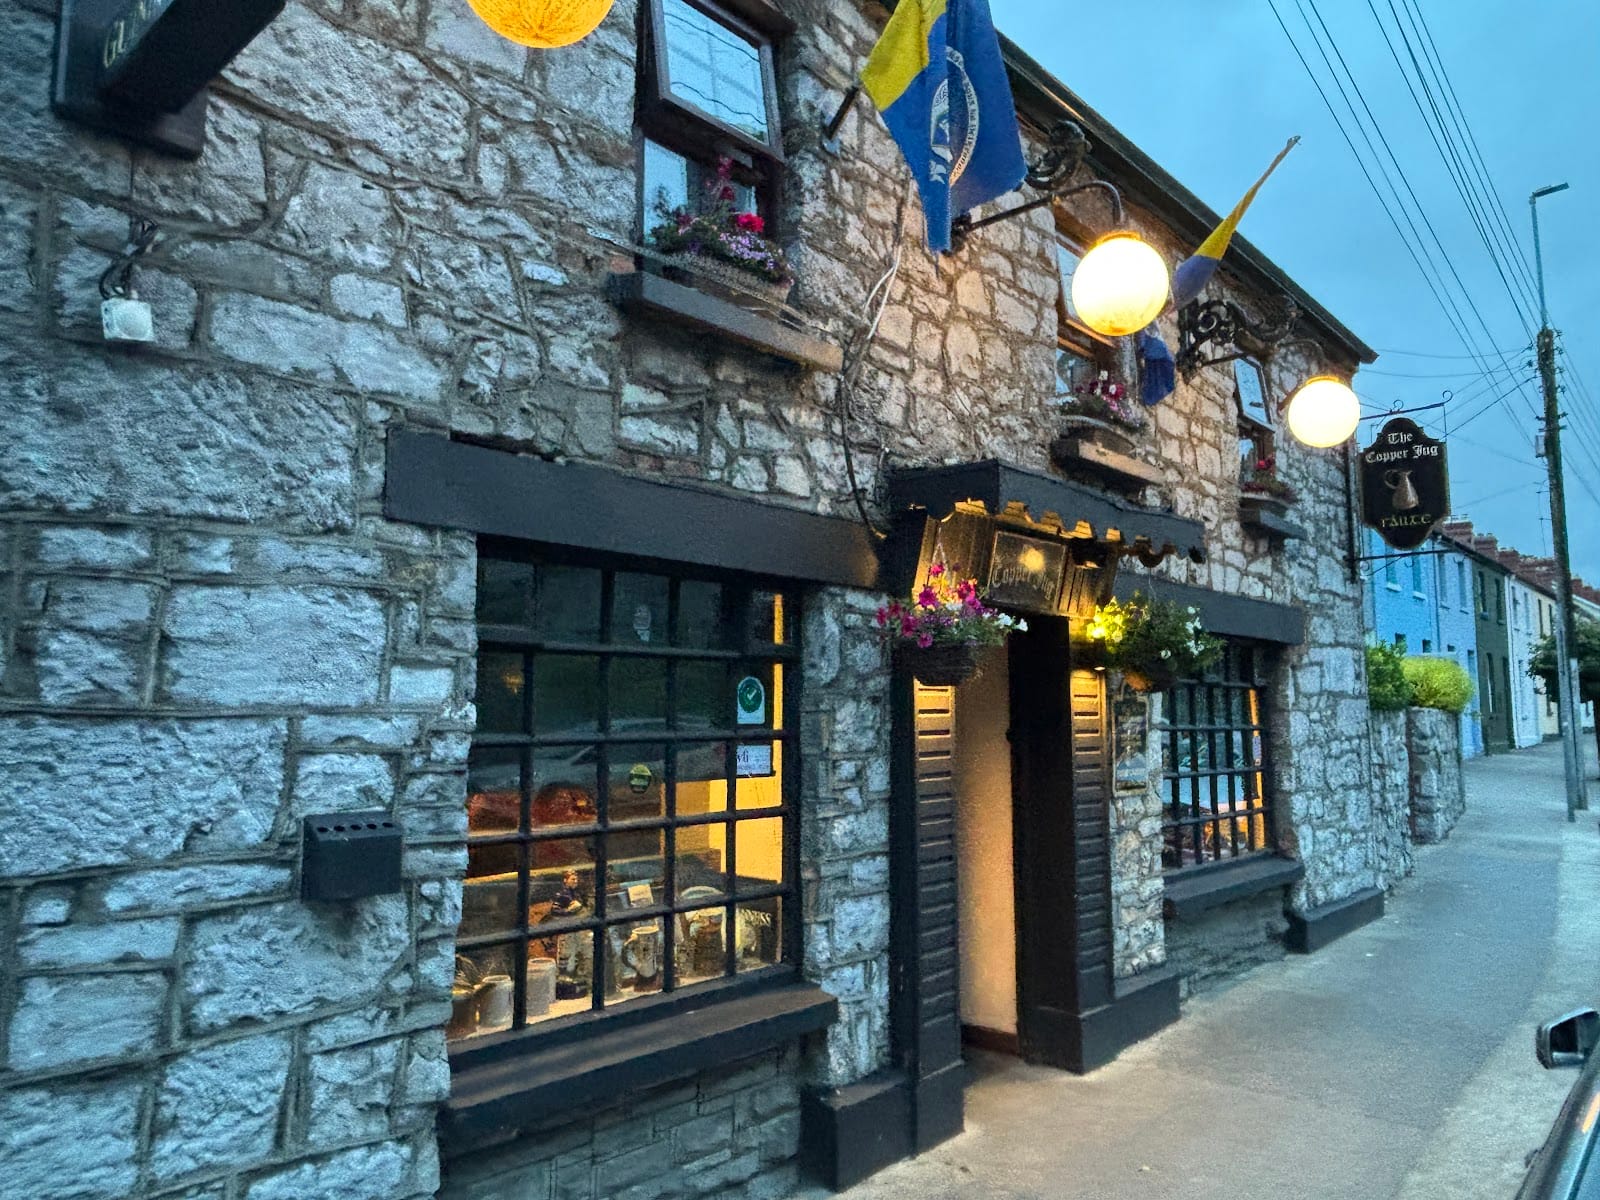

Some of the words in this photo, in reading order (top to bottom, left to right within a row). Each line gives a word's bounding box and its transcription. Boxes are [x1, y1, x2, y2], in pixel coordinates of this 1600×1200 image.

[1388, 432, 1413, 445] The
[1365, 449, 1409, 463] Copper
[1412, 444, 1439, 459] Jug
